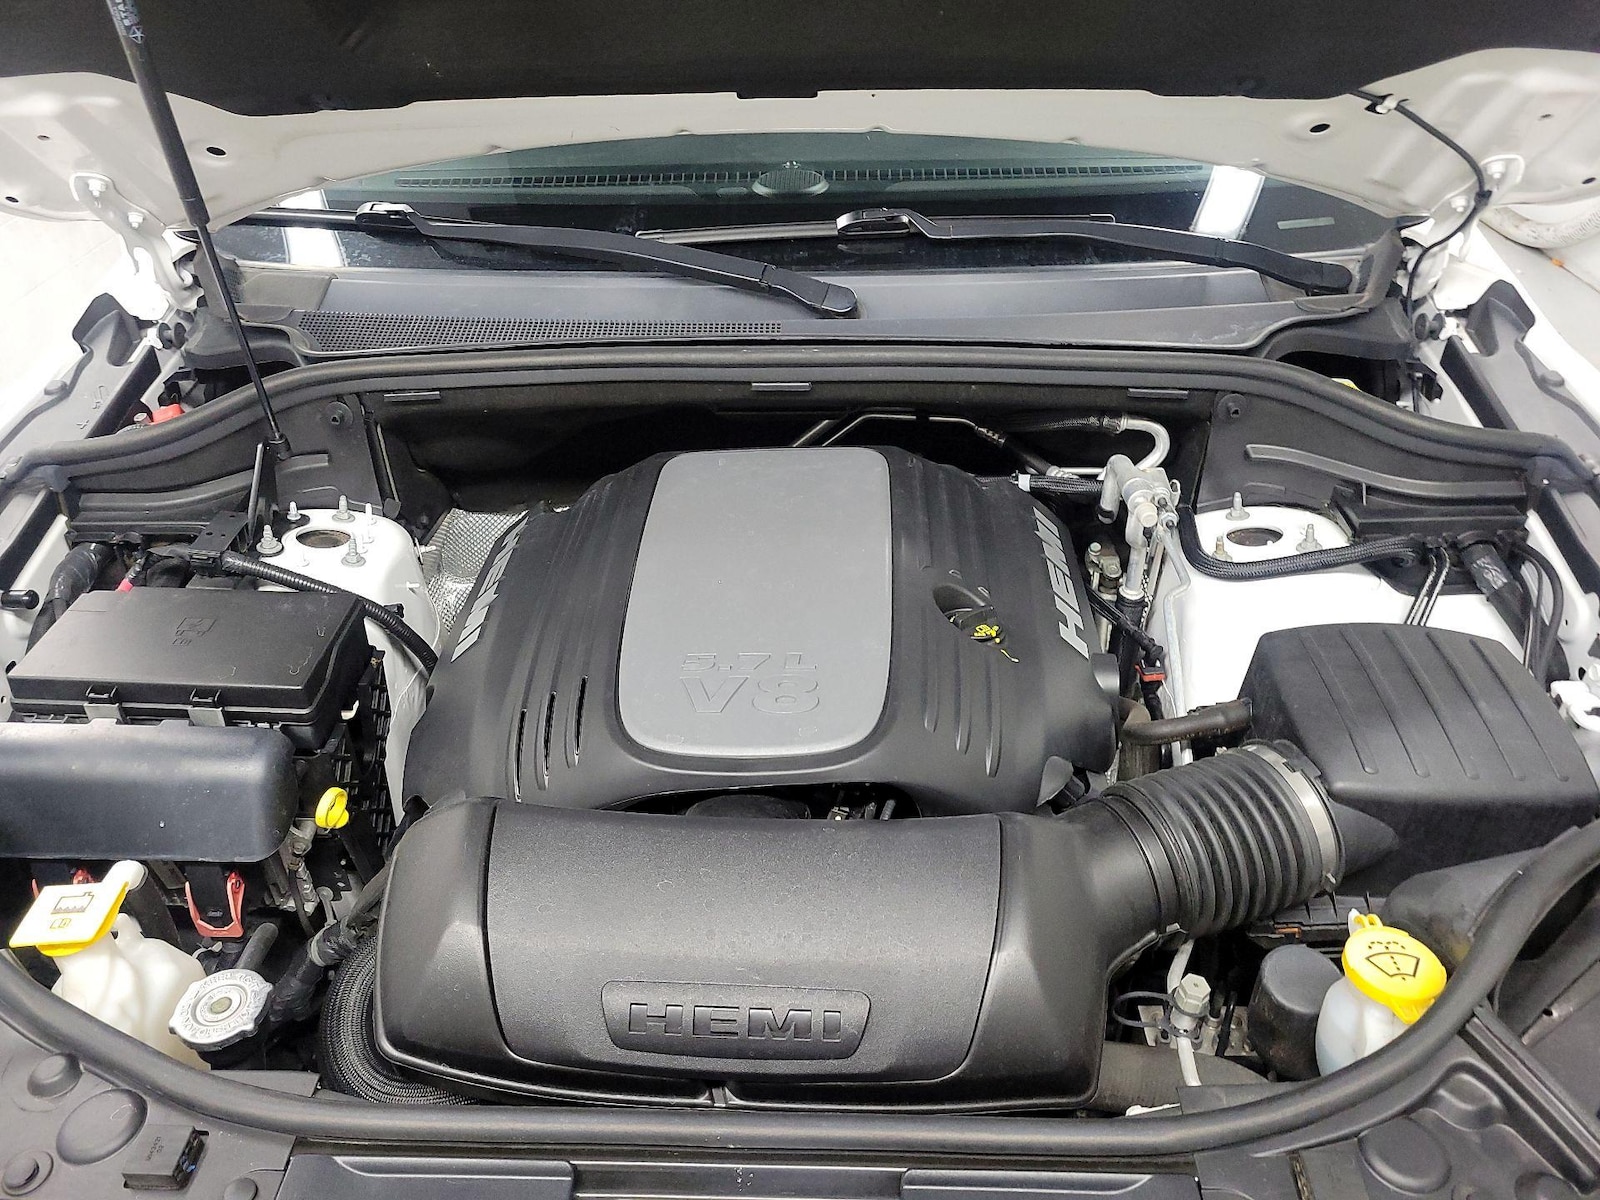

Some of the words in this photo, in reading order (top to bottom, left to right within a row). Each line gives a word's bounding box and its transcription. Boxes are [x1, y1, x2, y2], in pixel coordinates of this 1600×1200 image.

[450, 516, 529, 663] HEMI
[1033, 506, 1090, 660] HEMI
[680, 674, 820, 714] V8
[628, 1002, 842, 1043] HEMI
